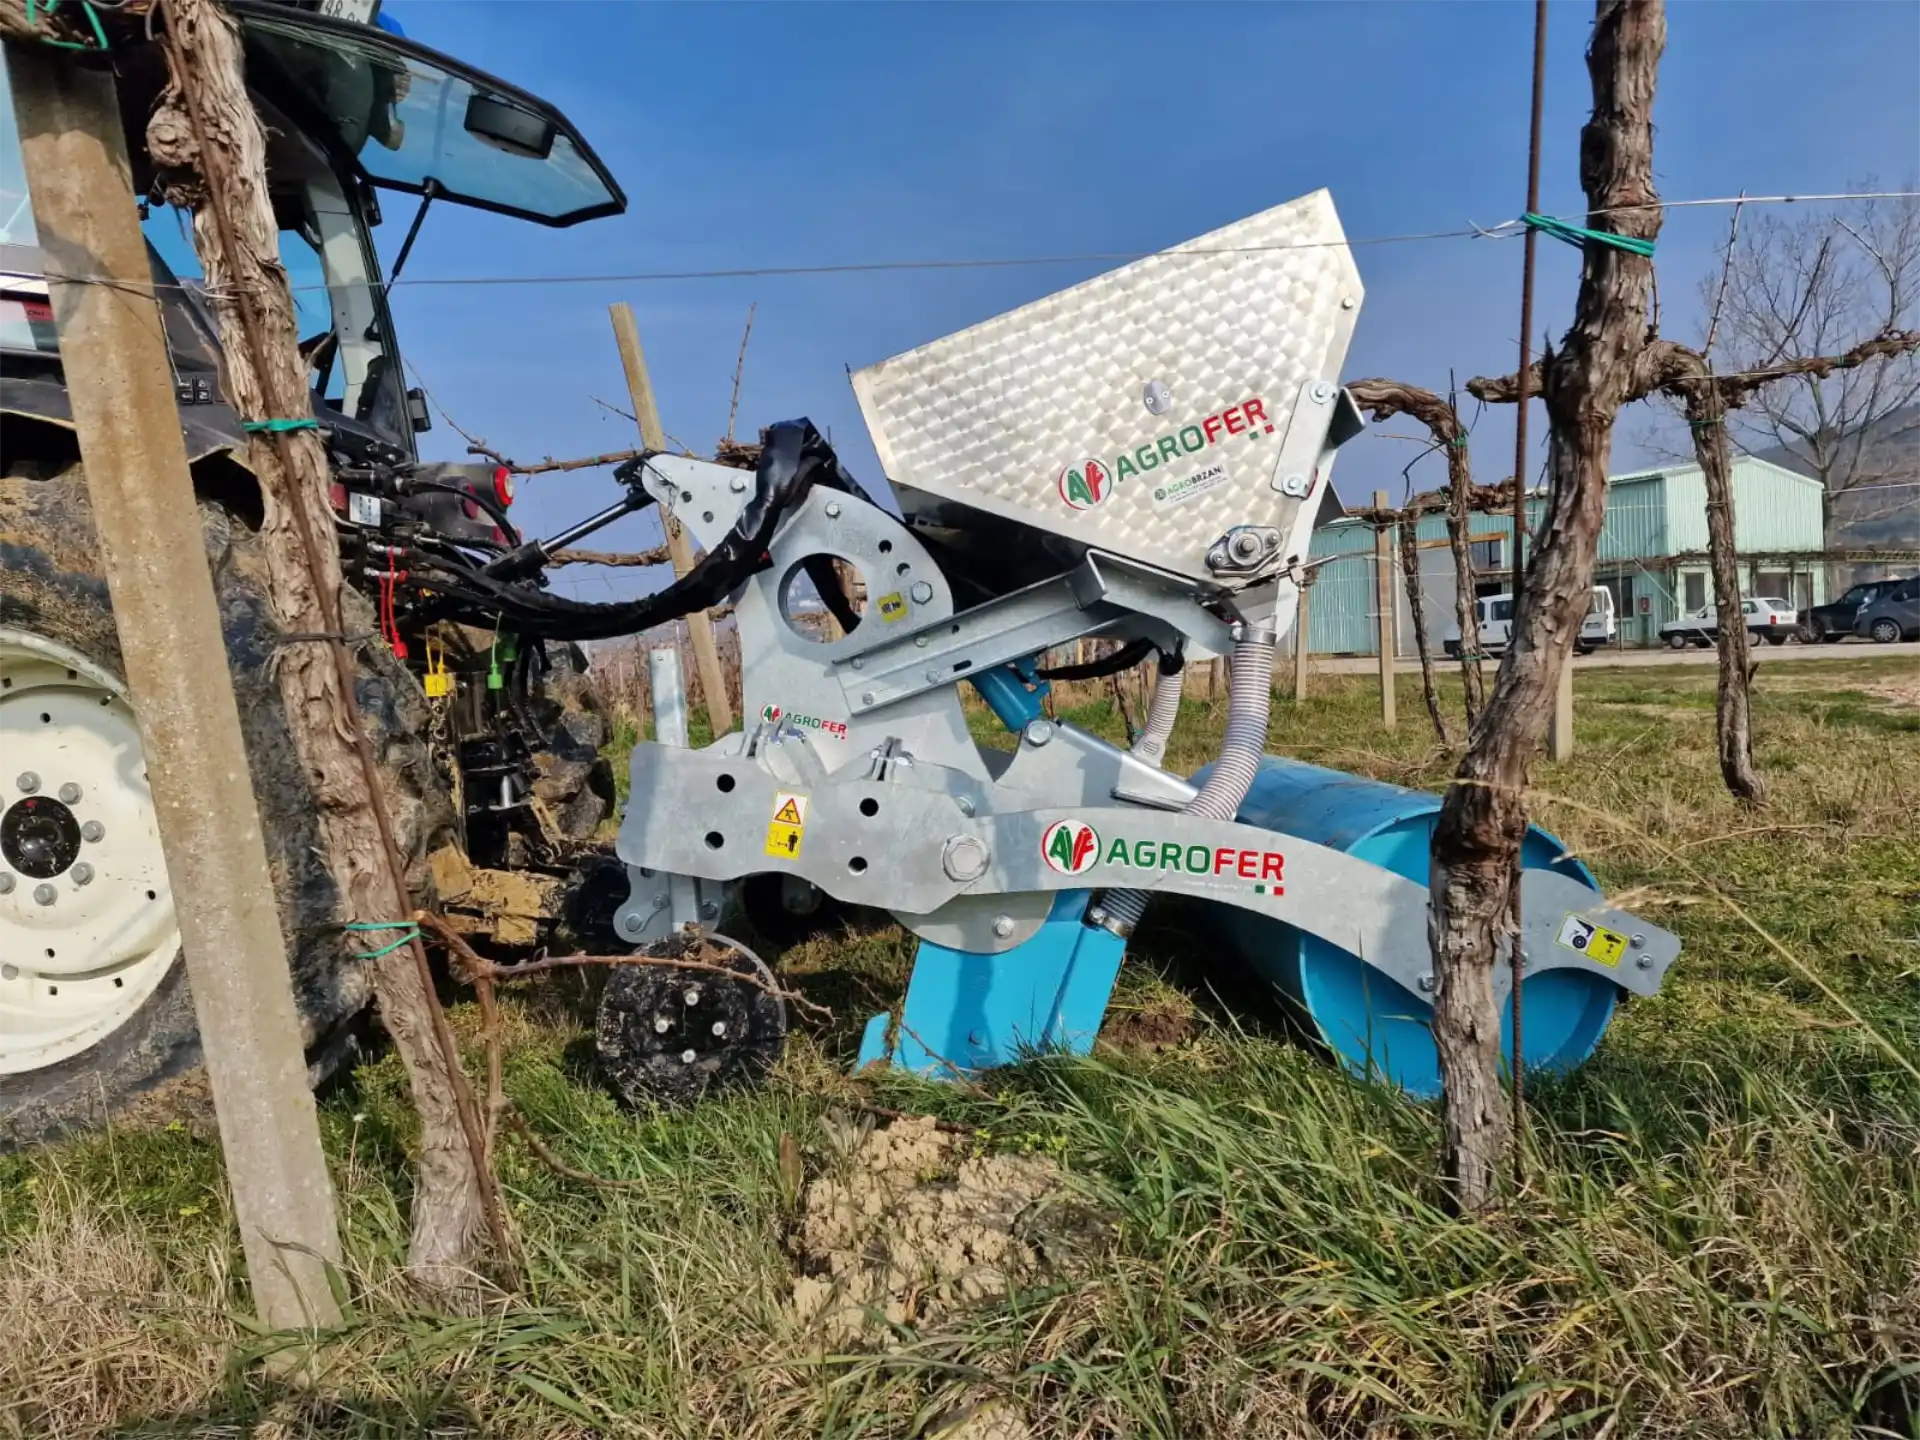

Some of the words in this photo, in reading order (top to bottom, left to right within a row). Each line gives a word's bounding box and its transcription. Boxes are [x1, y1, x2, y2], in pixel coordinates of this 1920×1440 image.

[1115, 397, 1269, 483] AGROFER
[1166, 464, 1226, 495] AGROBRZAN
[785, 711, 848, 734] AGROFER
[1105, 837, 1286, 882] AGROFER
